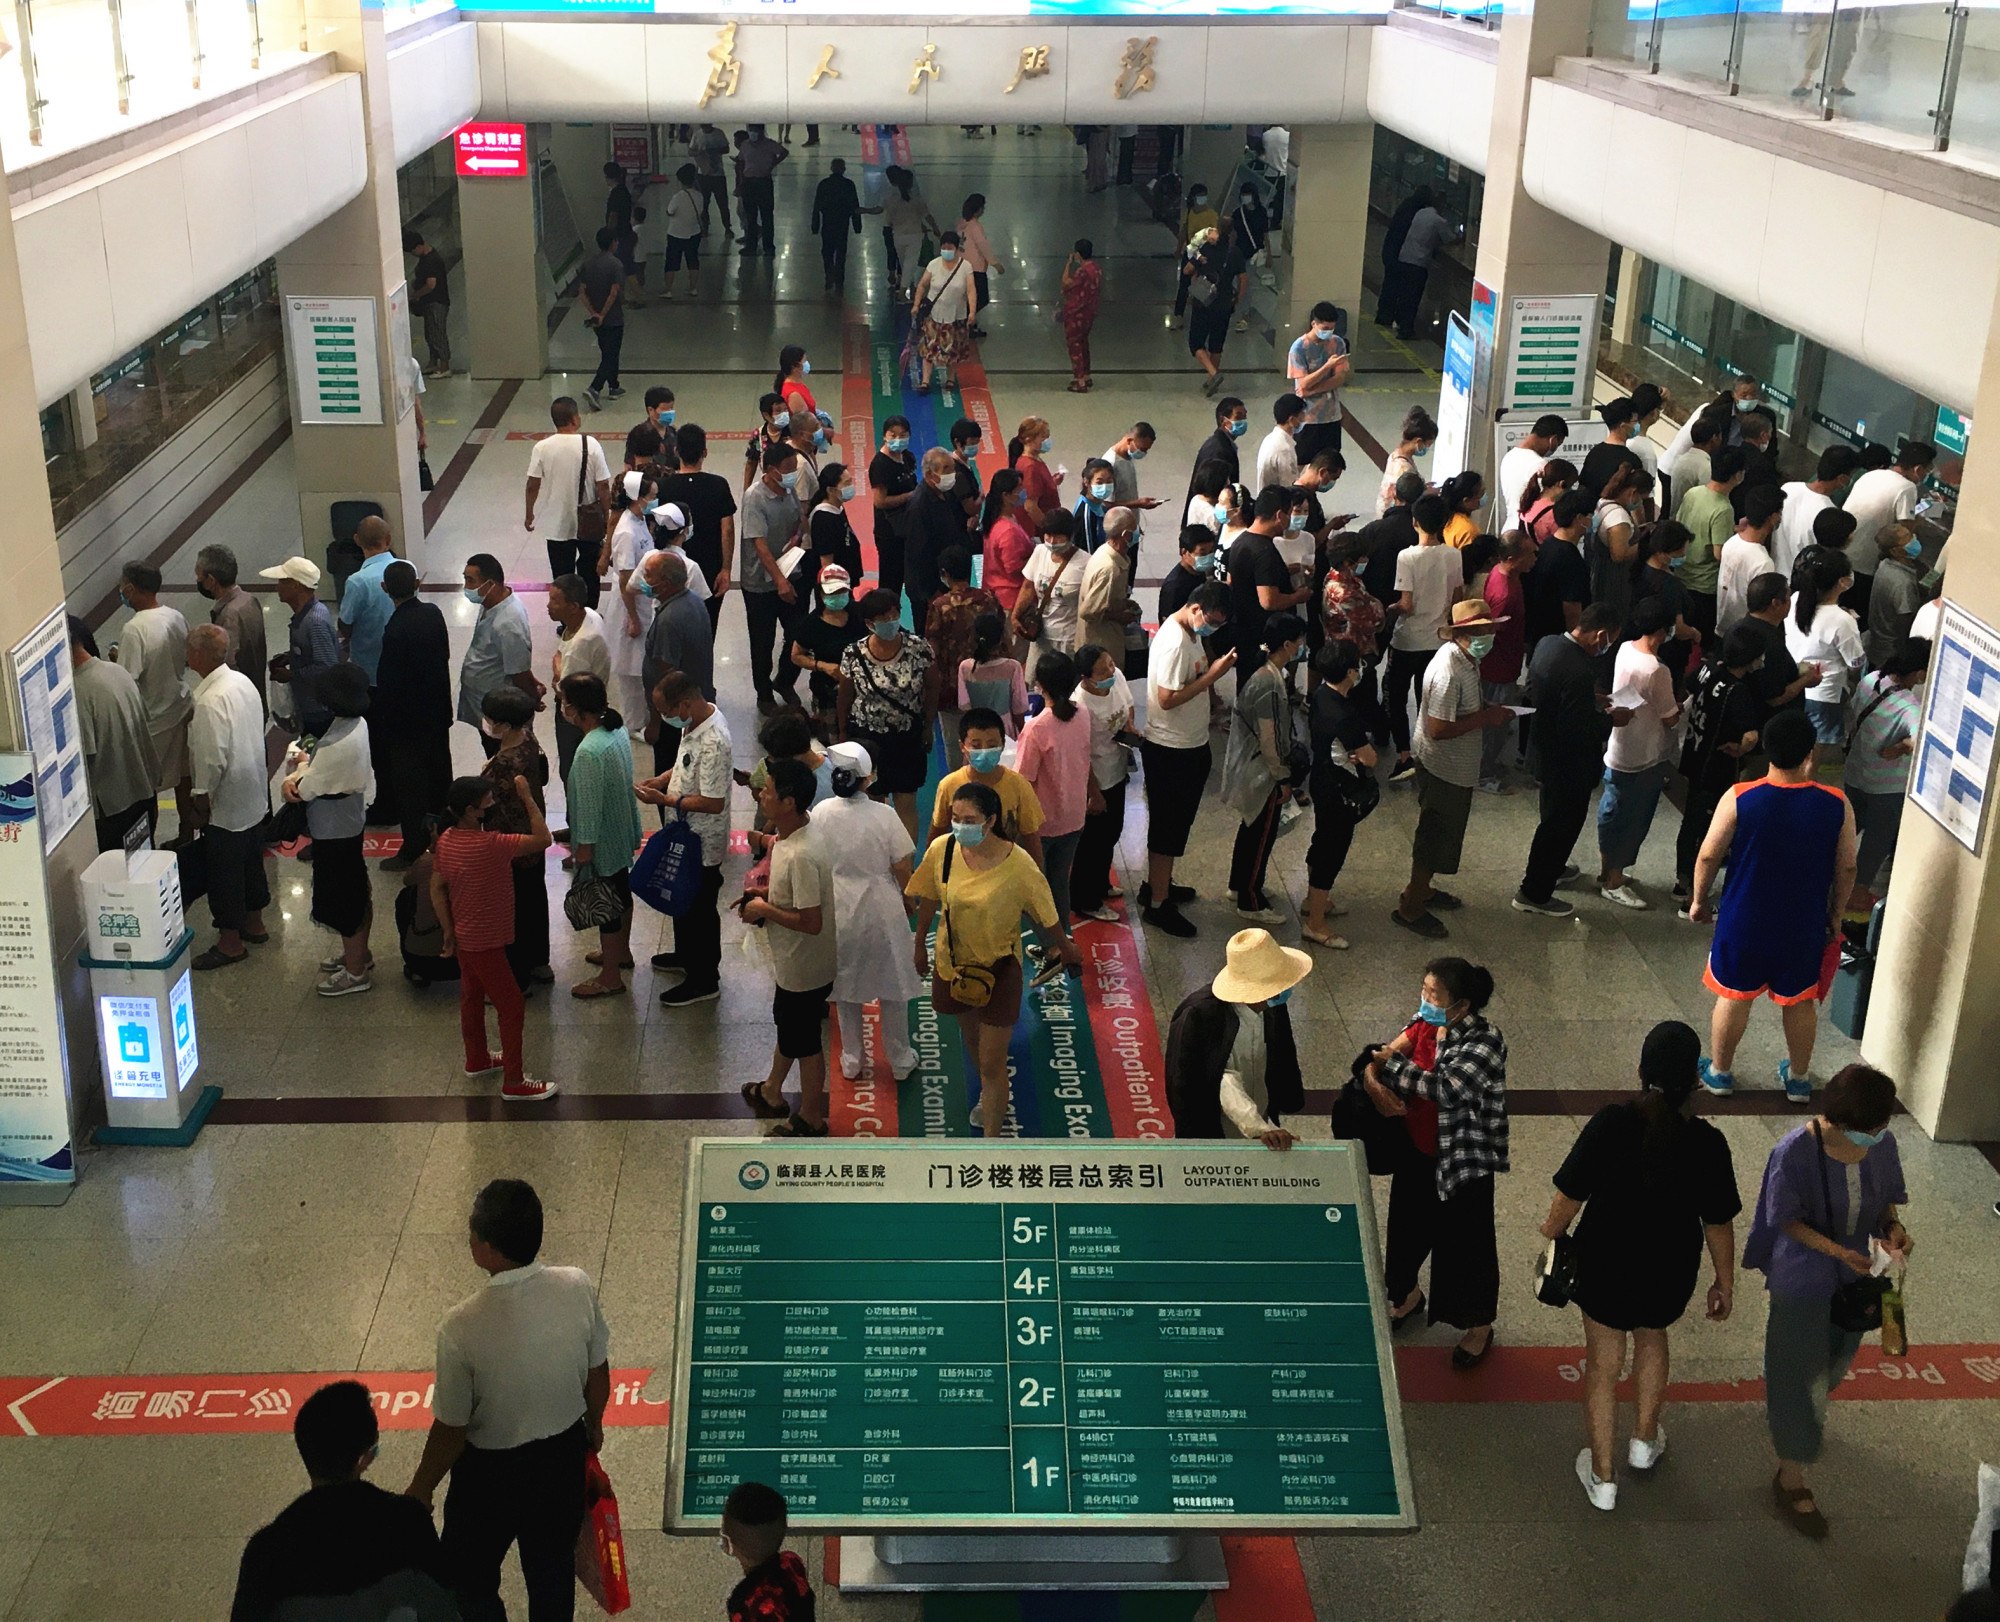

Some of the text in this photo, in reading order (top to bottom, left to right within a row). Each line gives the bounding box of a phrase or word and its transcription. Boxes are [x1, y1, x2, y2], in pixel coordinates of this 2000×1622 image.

[1091, 943, 1134, 1009] 门诊收费
[1050, 1026, 1085, 1098] Imaging
[1112, 1017, 1160, 1114] Outpatient
[1183, 1166, 1250, 1175] LAYOUT OF
[928, 1164, 1164, 1188] 门诊楼楼层总索引
[1184, 1177, 1321, 1188] OUTPATIENT BUILDING
[1012, 1217, 1048, 1244] 5F
[1014, 1267, 1050, 1295] 4F
[786, 1307, 829, 1315] 口腔科门诊
[1016, 1316, 1053, 1345] 3F
[1077, 1369, 1112, 1378] 儿科门诊
[1164, 1369, 1199, 1378] 妇科门诊
[1271, 1370, 1307, 1378] 产科门诊
[864, 1389, 909, 1398] 门诊治疗室
[939, 1389, 984, 1398] 门诊手术室
[1019, 1377, 1056, 1407] 2F
[782, 1430, 818, 1439] 急诊内科
[864, 1429, 900, 1439] 急诊外科
[864, 1454, 879, 1462] DR
[1081, 1454, 1135, 1463] 神经内科门诊
[1022, 1456, 1060, 1488] 1F
[864, 1474, 896, 1483] 口腔CT
[1082, 1473, 1137, 1483] 中医内科门诊
[1282, 1475, 1336, 1484] 内分泌科门诊
[1084, 1495, 1139, 1504] 消化内科门诊
